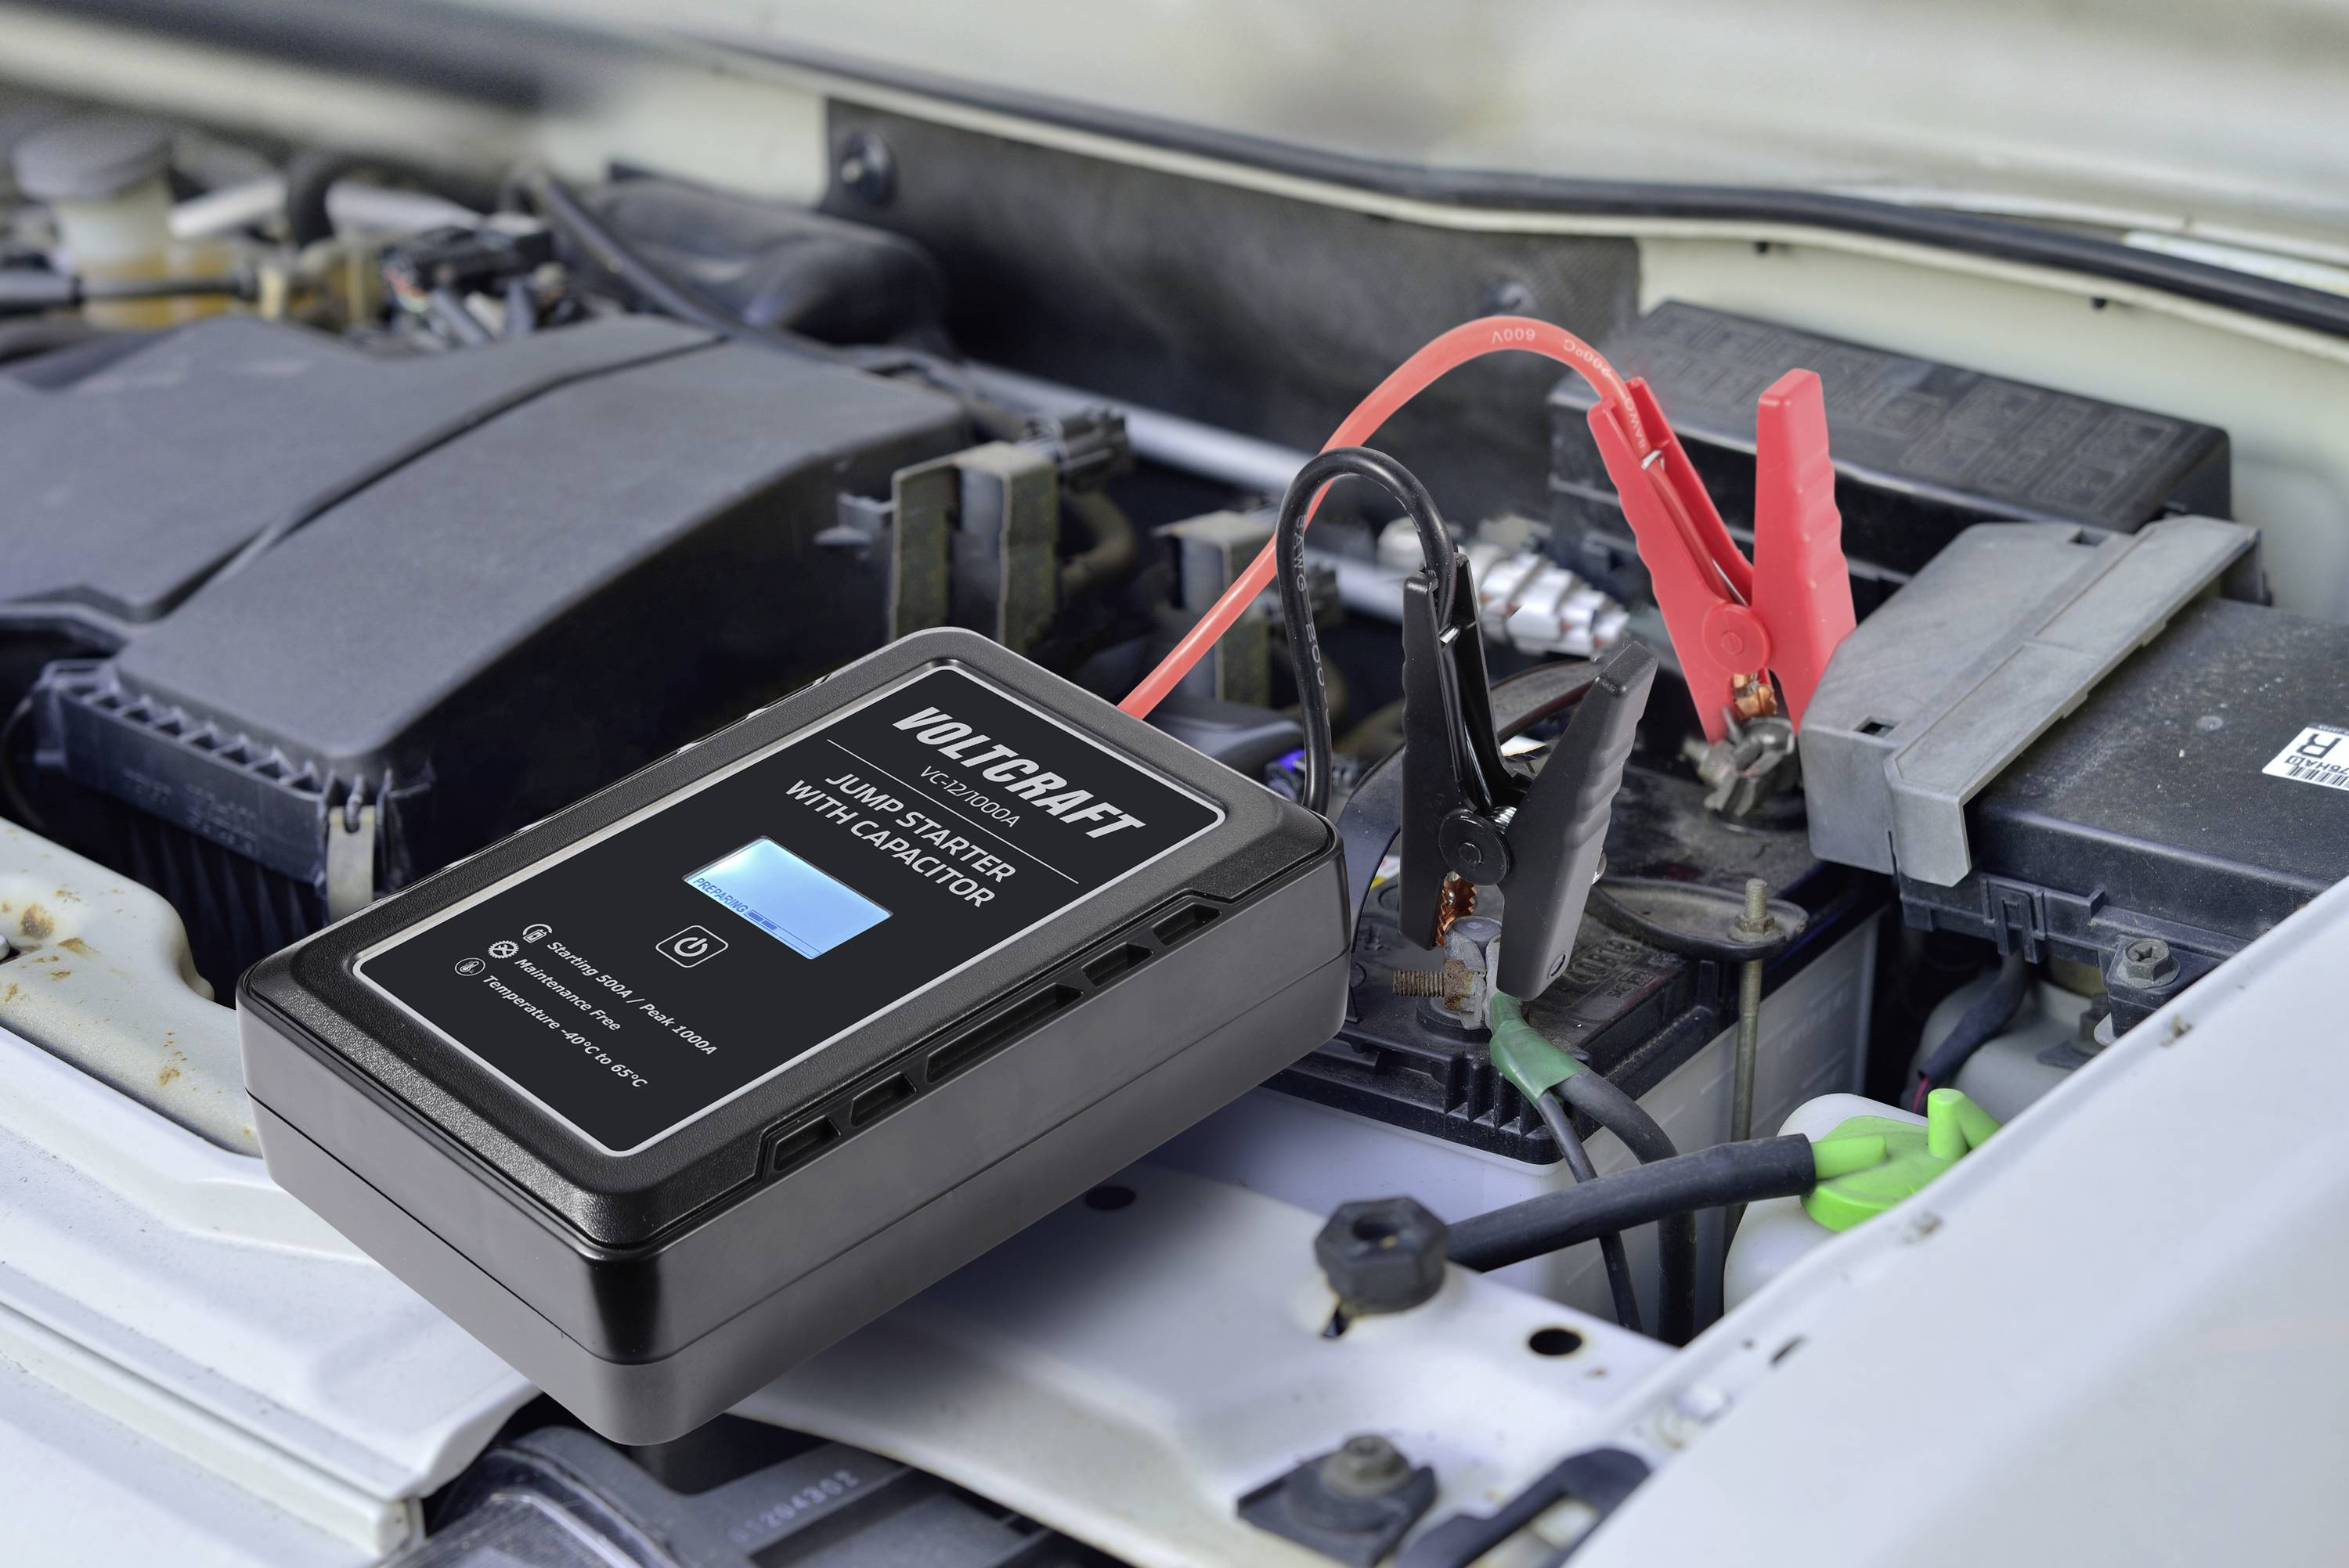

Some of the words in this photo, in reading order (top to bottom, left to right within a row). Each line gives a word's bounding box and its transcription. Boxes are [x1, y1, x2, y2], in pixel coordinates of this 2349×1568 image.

[1491, 327, 1535, 344] 600V
[1294, 514, 1308, 593] 8AWG
[892, 706, 1146, 838] VOLTCRAFT
[920, 766, 1020, 827] VC-12/1000A
[785, 779, 859, 825] WITH
[850, 820, 995, 908] CAPACITOR
[824, 773, 904, 813] JUMP
[895, 811, 1016, 883] STARTER
[693, 878, 749, 913] PREPARING
[482, 975, 561, 1029] Temperature
[594, 1053, 612, 1065] to
[514, 958, 592, 1011] Maintenance
[589, 1009, 621, 1031] Free
[547, 942, 599, 976] Starting
[595, 974, 633, 999] 500A
[639, 1003, 675, 1027] Peak
[671, 1026, 717, 1055] 1000A
